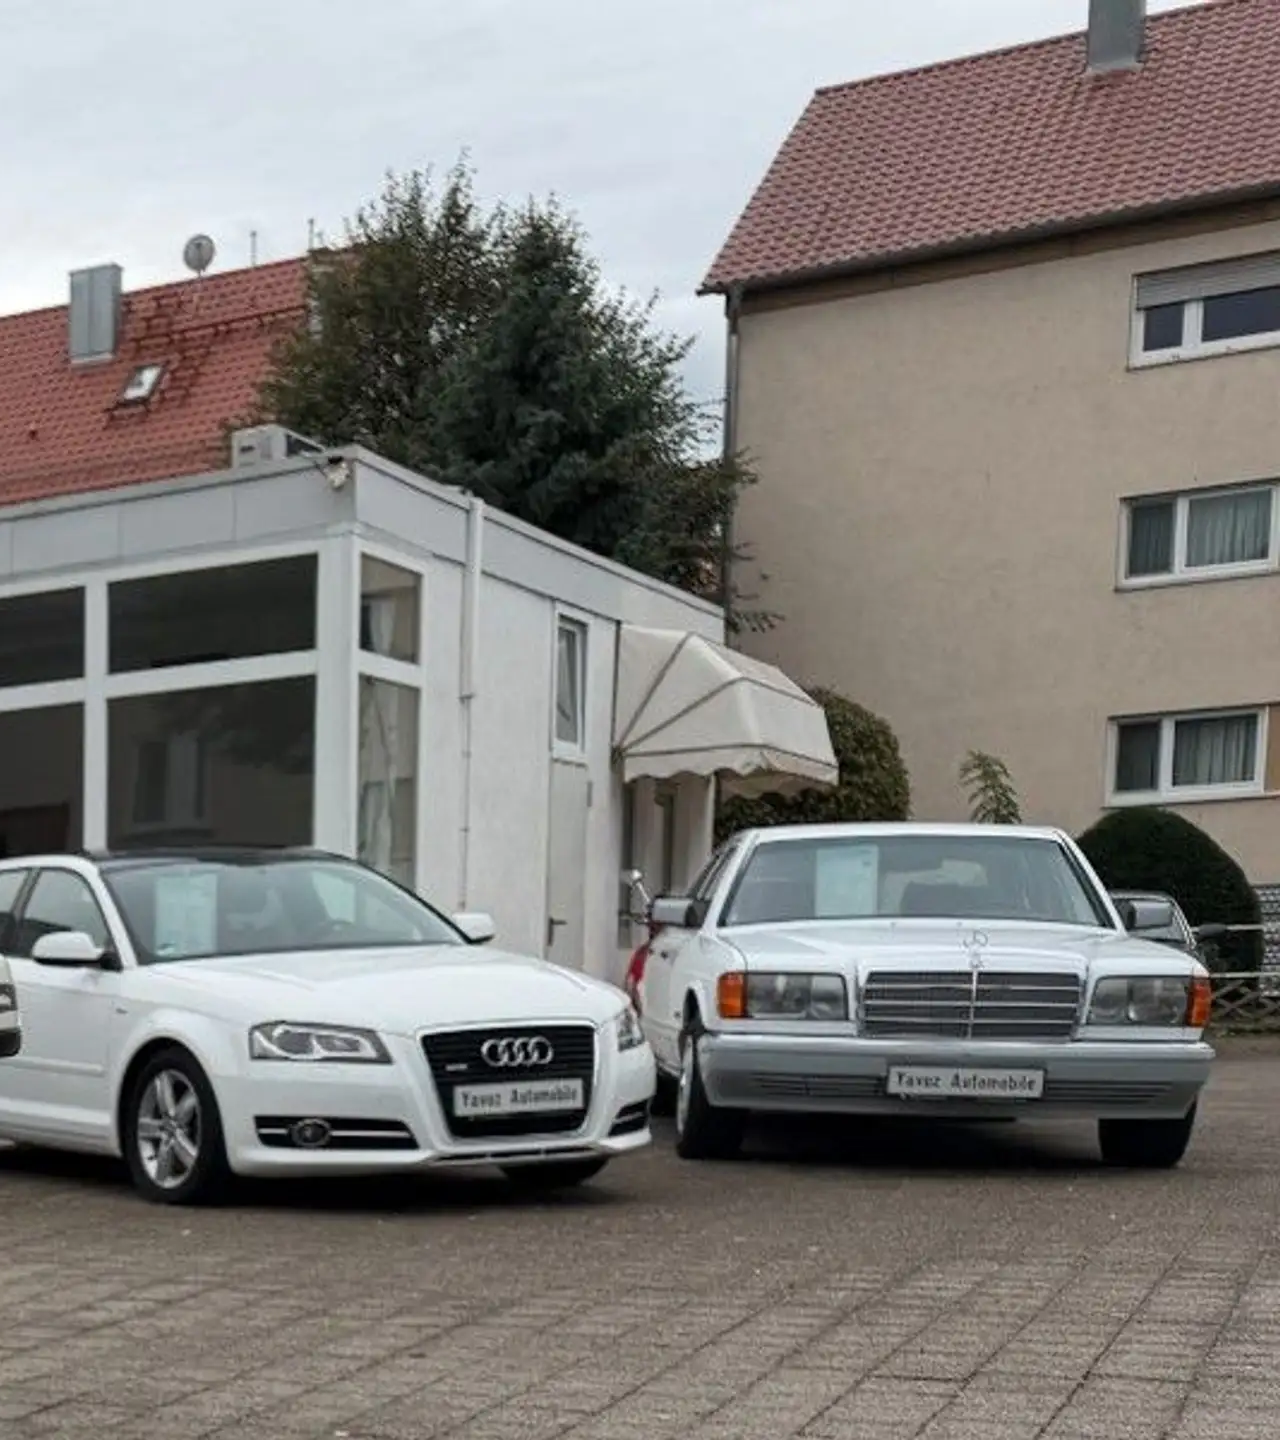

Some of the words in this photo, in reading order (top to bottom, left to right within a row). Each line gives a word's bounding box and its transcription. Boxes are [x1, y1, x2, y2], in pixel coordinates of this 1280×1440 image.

[896, 1072, 942, 1088] Yavuz
[951, 1072, 1037, 1091] Automobile
[510, 1084, 577, 1105] Automobile
